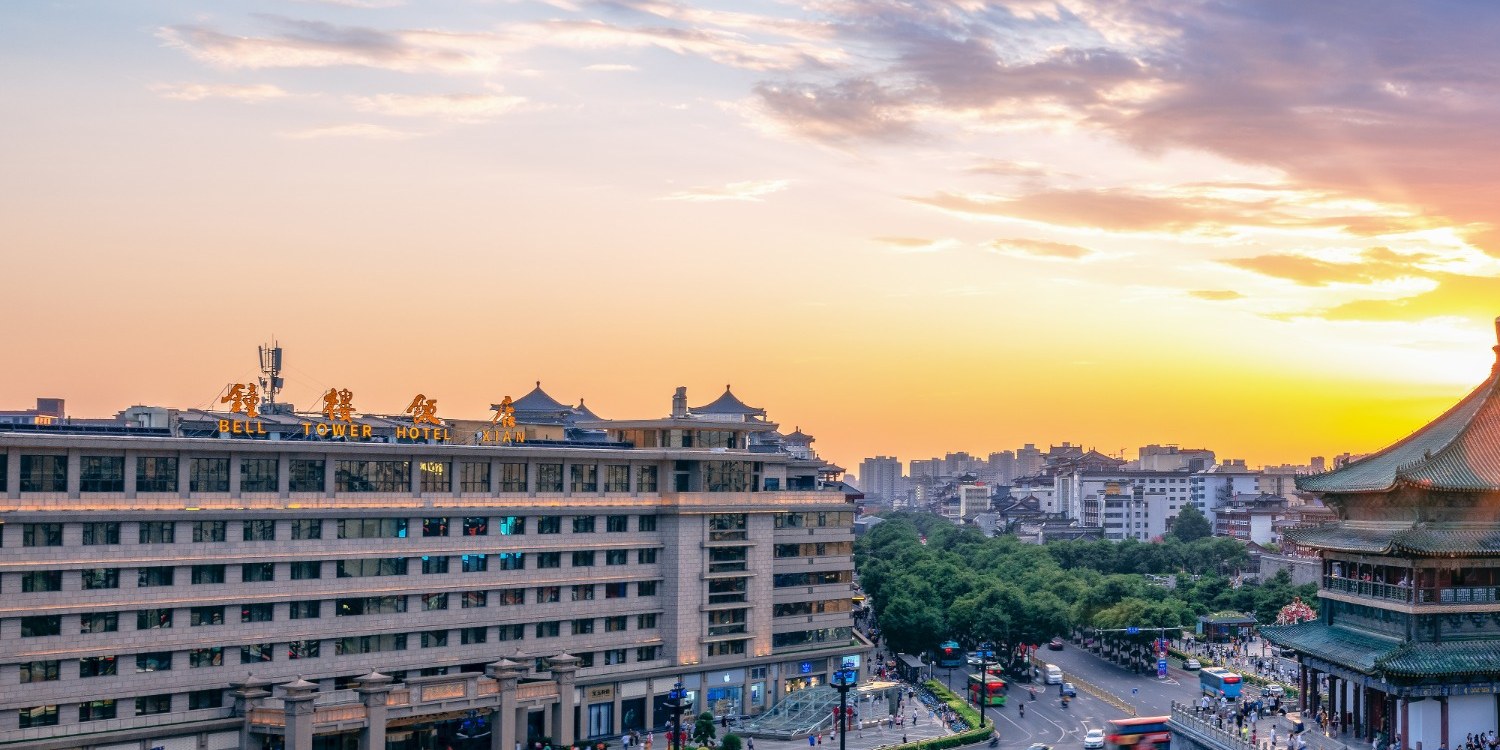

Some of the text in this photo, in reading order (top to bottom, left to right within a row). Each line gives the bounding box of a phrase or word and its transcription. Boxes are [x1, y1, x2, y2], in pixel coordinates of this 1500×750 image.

[219, 419, 526, 443] BELL TOWER HOTEL XIAN
